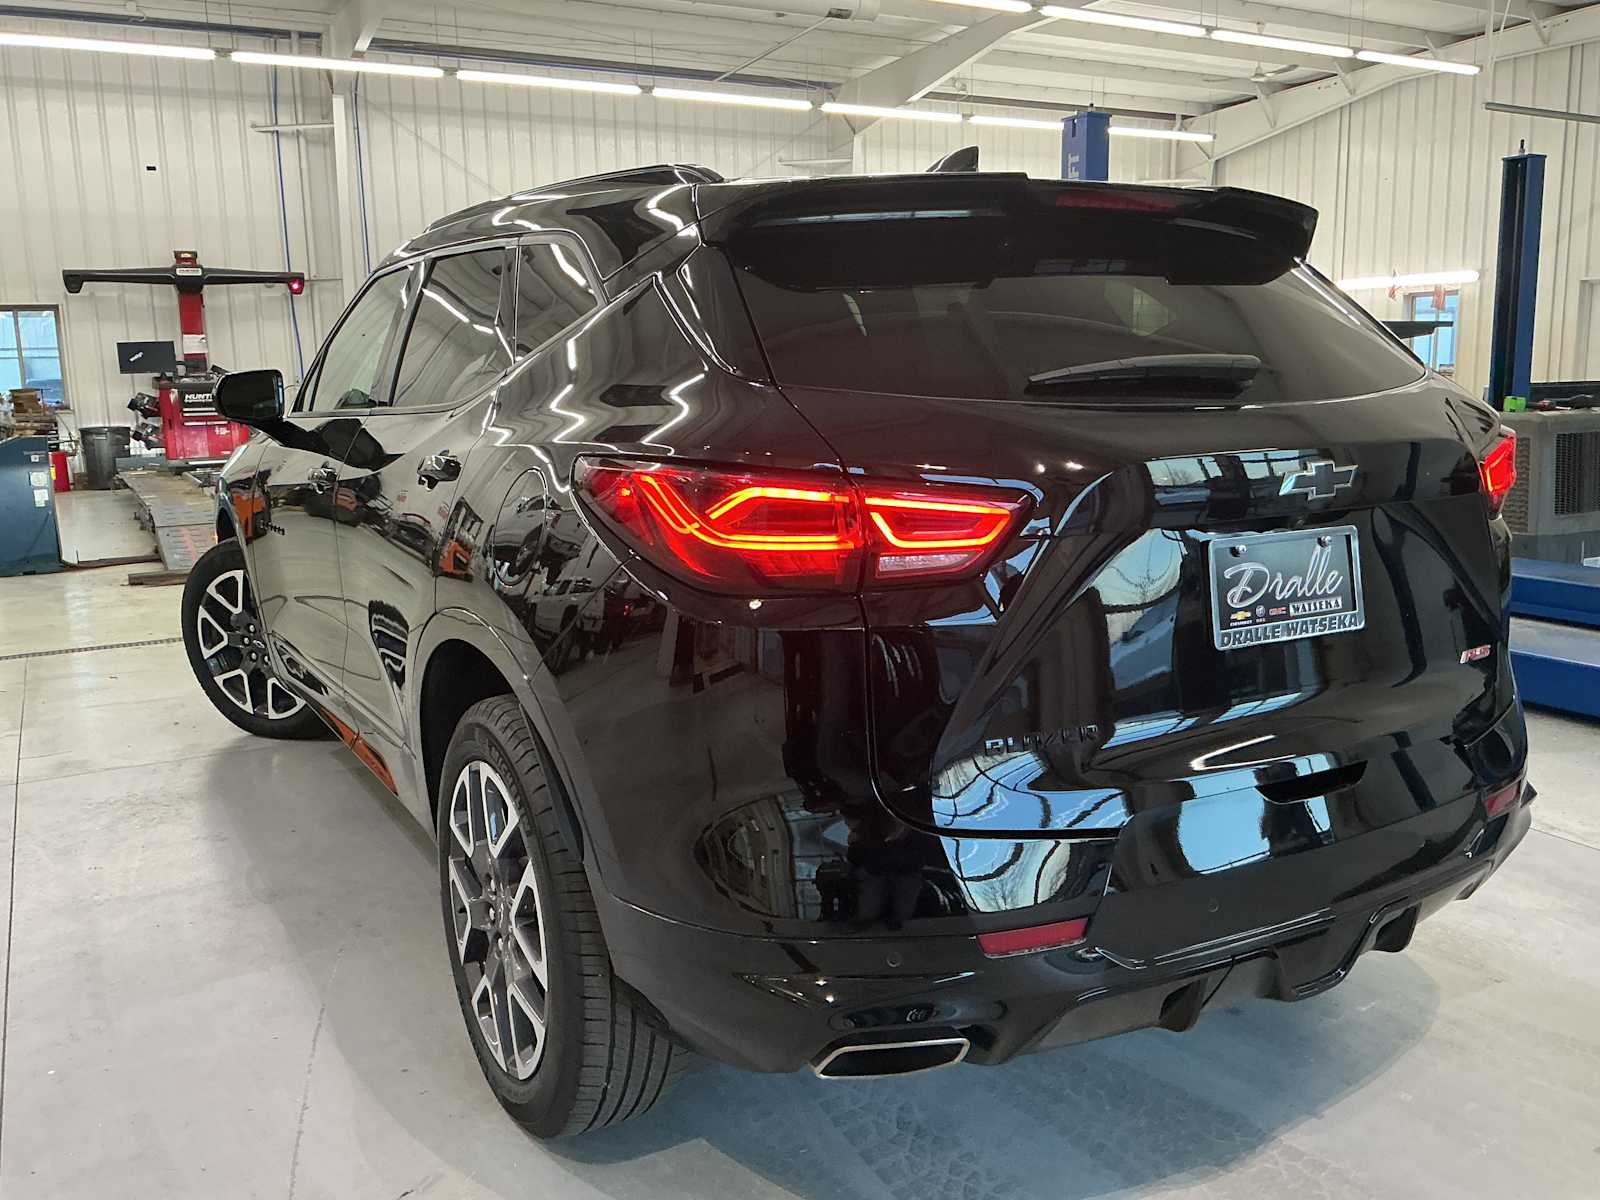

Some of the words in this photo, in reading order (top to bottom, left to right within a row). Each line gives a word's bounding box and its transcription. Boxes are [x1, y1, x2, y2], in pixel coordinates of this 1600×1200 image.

[1223, 546, 1344, 609] Dralle
[1291, 599, 1341, 614] WATSEKA
[1221, 626, 1281, 646] DRALLE
[1287, 614, 1358, 637] WATSEKA
